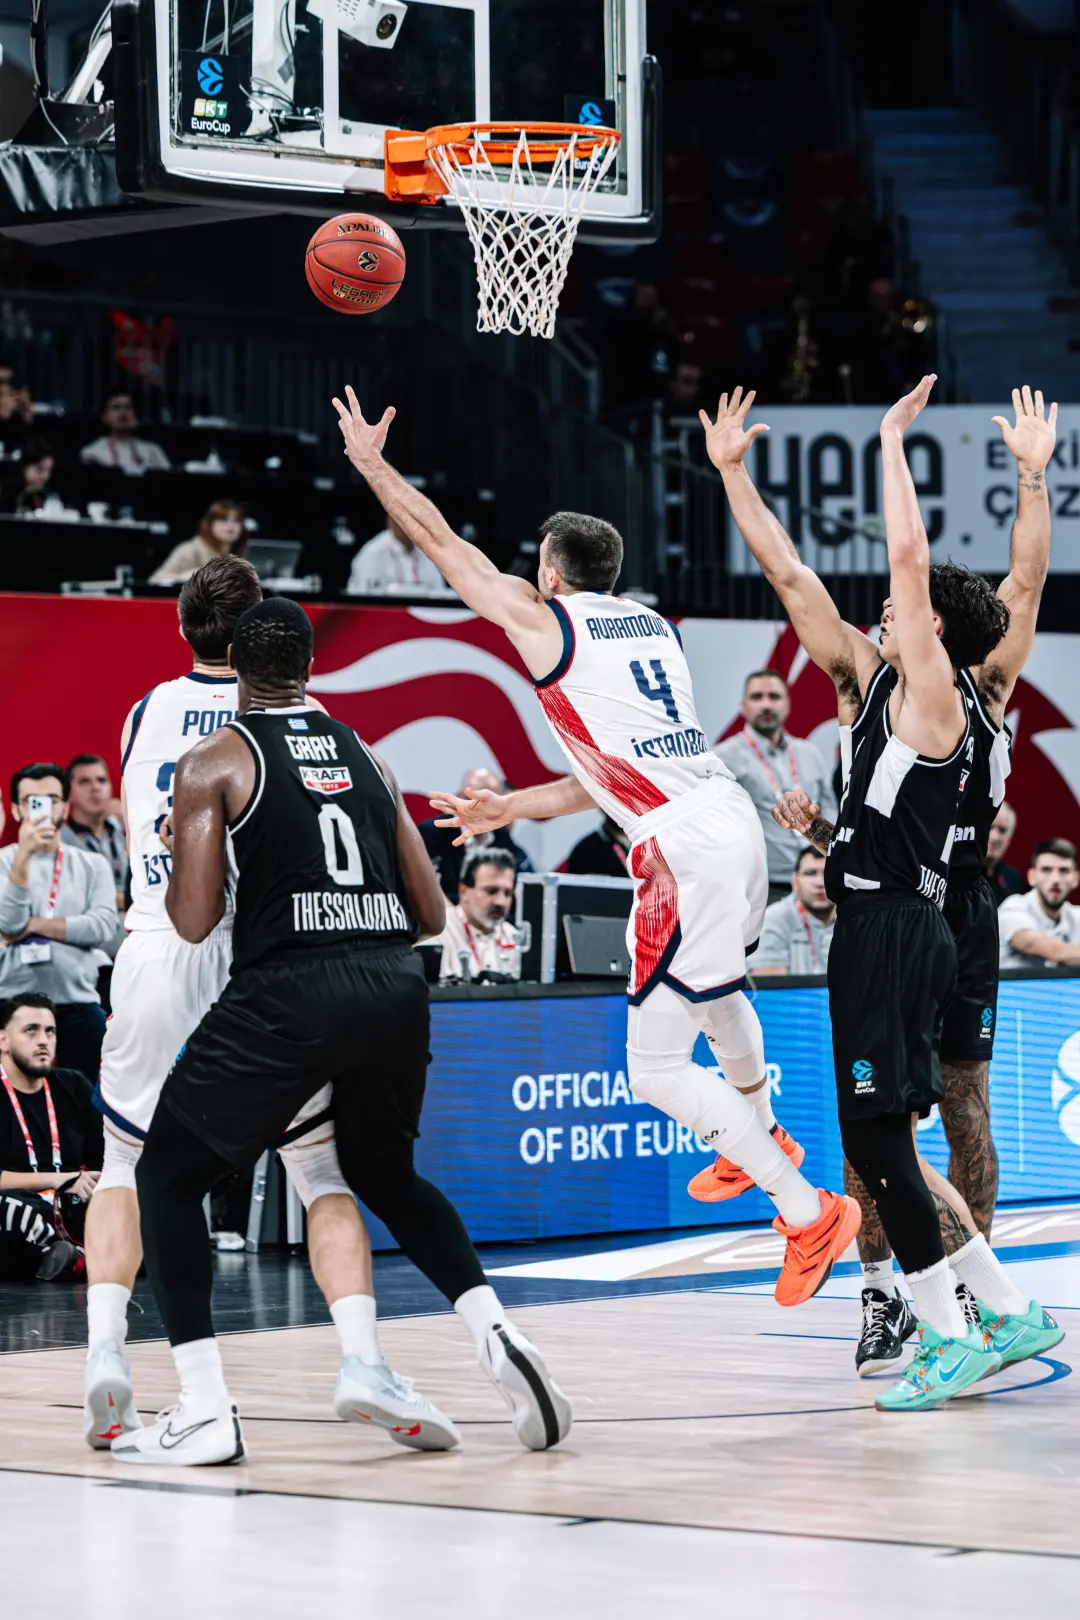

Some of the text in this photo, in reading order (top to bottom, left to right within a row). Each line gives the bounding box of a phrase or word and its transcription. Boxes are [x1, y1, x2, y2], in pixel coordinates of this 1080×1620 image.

[194, 99, 227, 118] BKT
[191, 117, 231, 135] EuroCup
[331, 278, 387, 299] LEGACY
[629, 659, 682, 724] 4
[284, 735, 338, 761] GRAY
[301, 769, 347, 780] KRAFT
[318, 803, 364, 886] 0
[520, 1127, 564, 1165] OF
[570, 1123, 630, 1162] BKT
